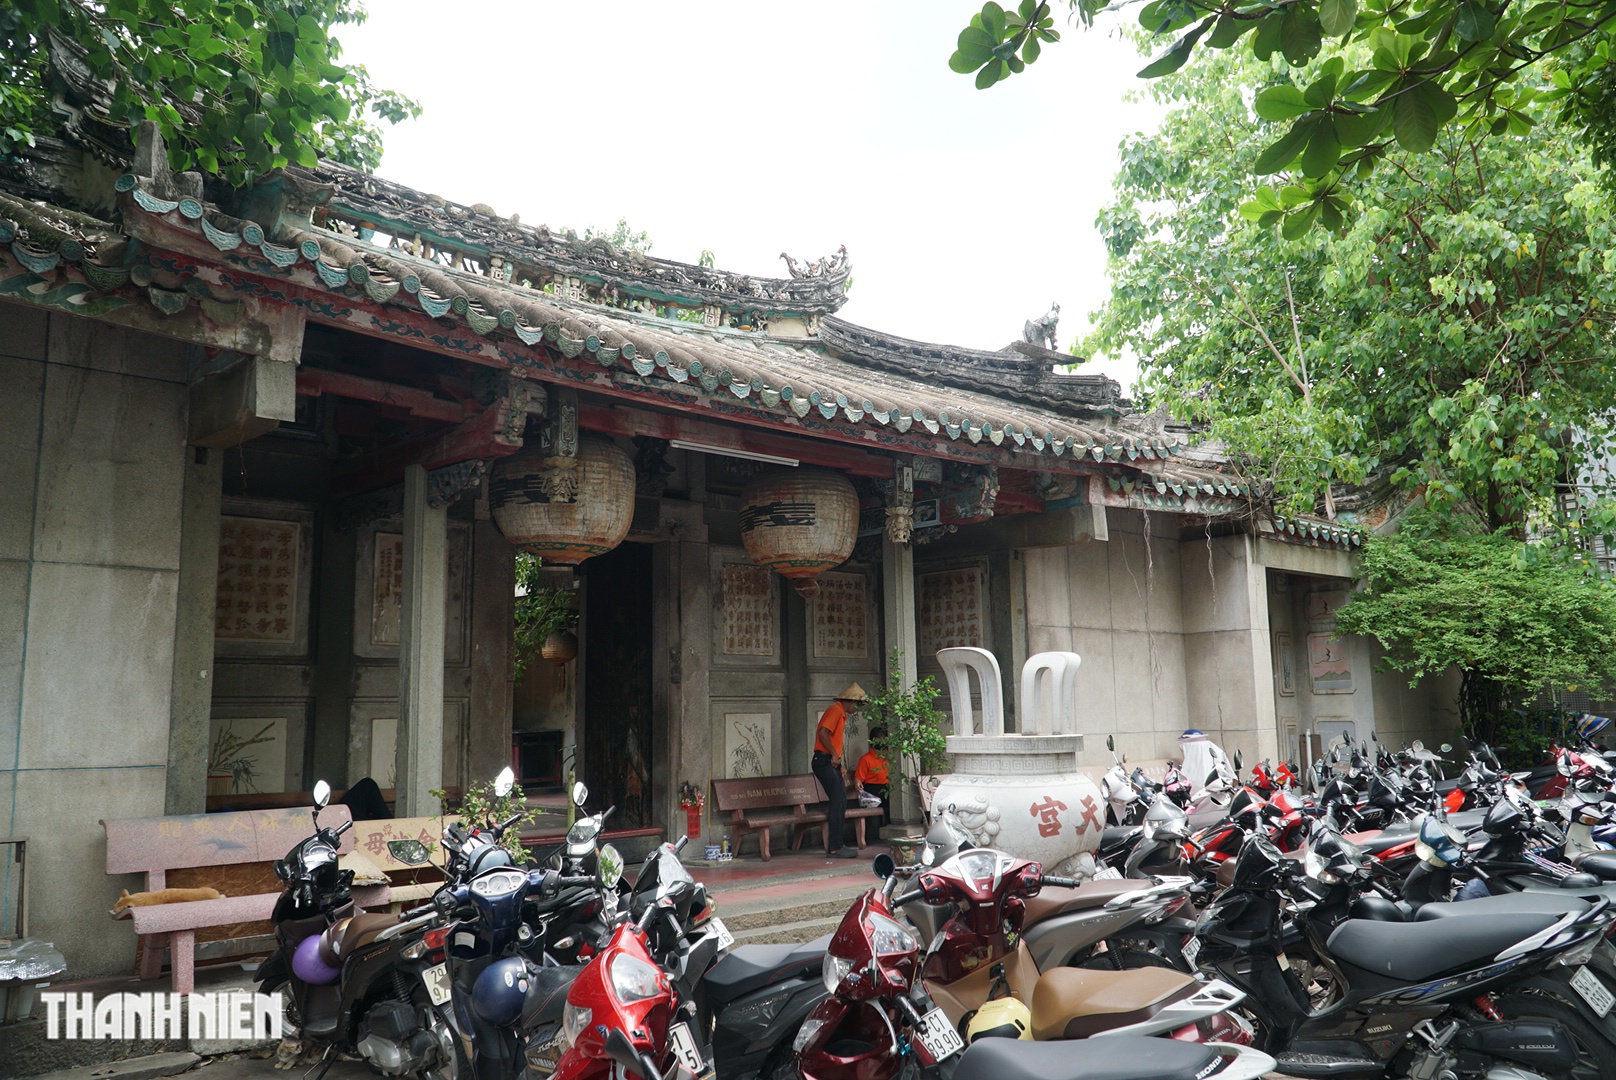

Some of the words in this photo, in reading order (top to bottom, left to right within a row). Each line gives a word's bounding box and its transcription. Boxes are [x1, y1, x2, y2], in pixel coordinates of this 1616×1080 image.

[747, 789, 763, 798] NAM
[1366, 1024, 1393, 1034] SUZUKI
[1207, 1028, 1232, 1043] HONDA
[1194, 1055, 1223, 1080] HONDA
